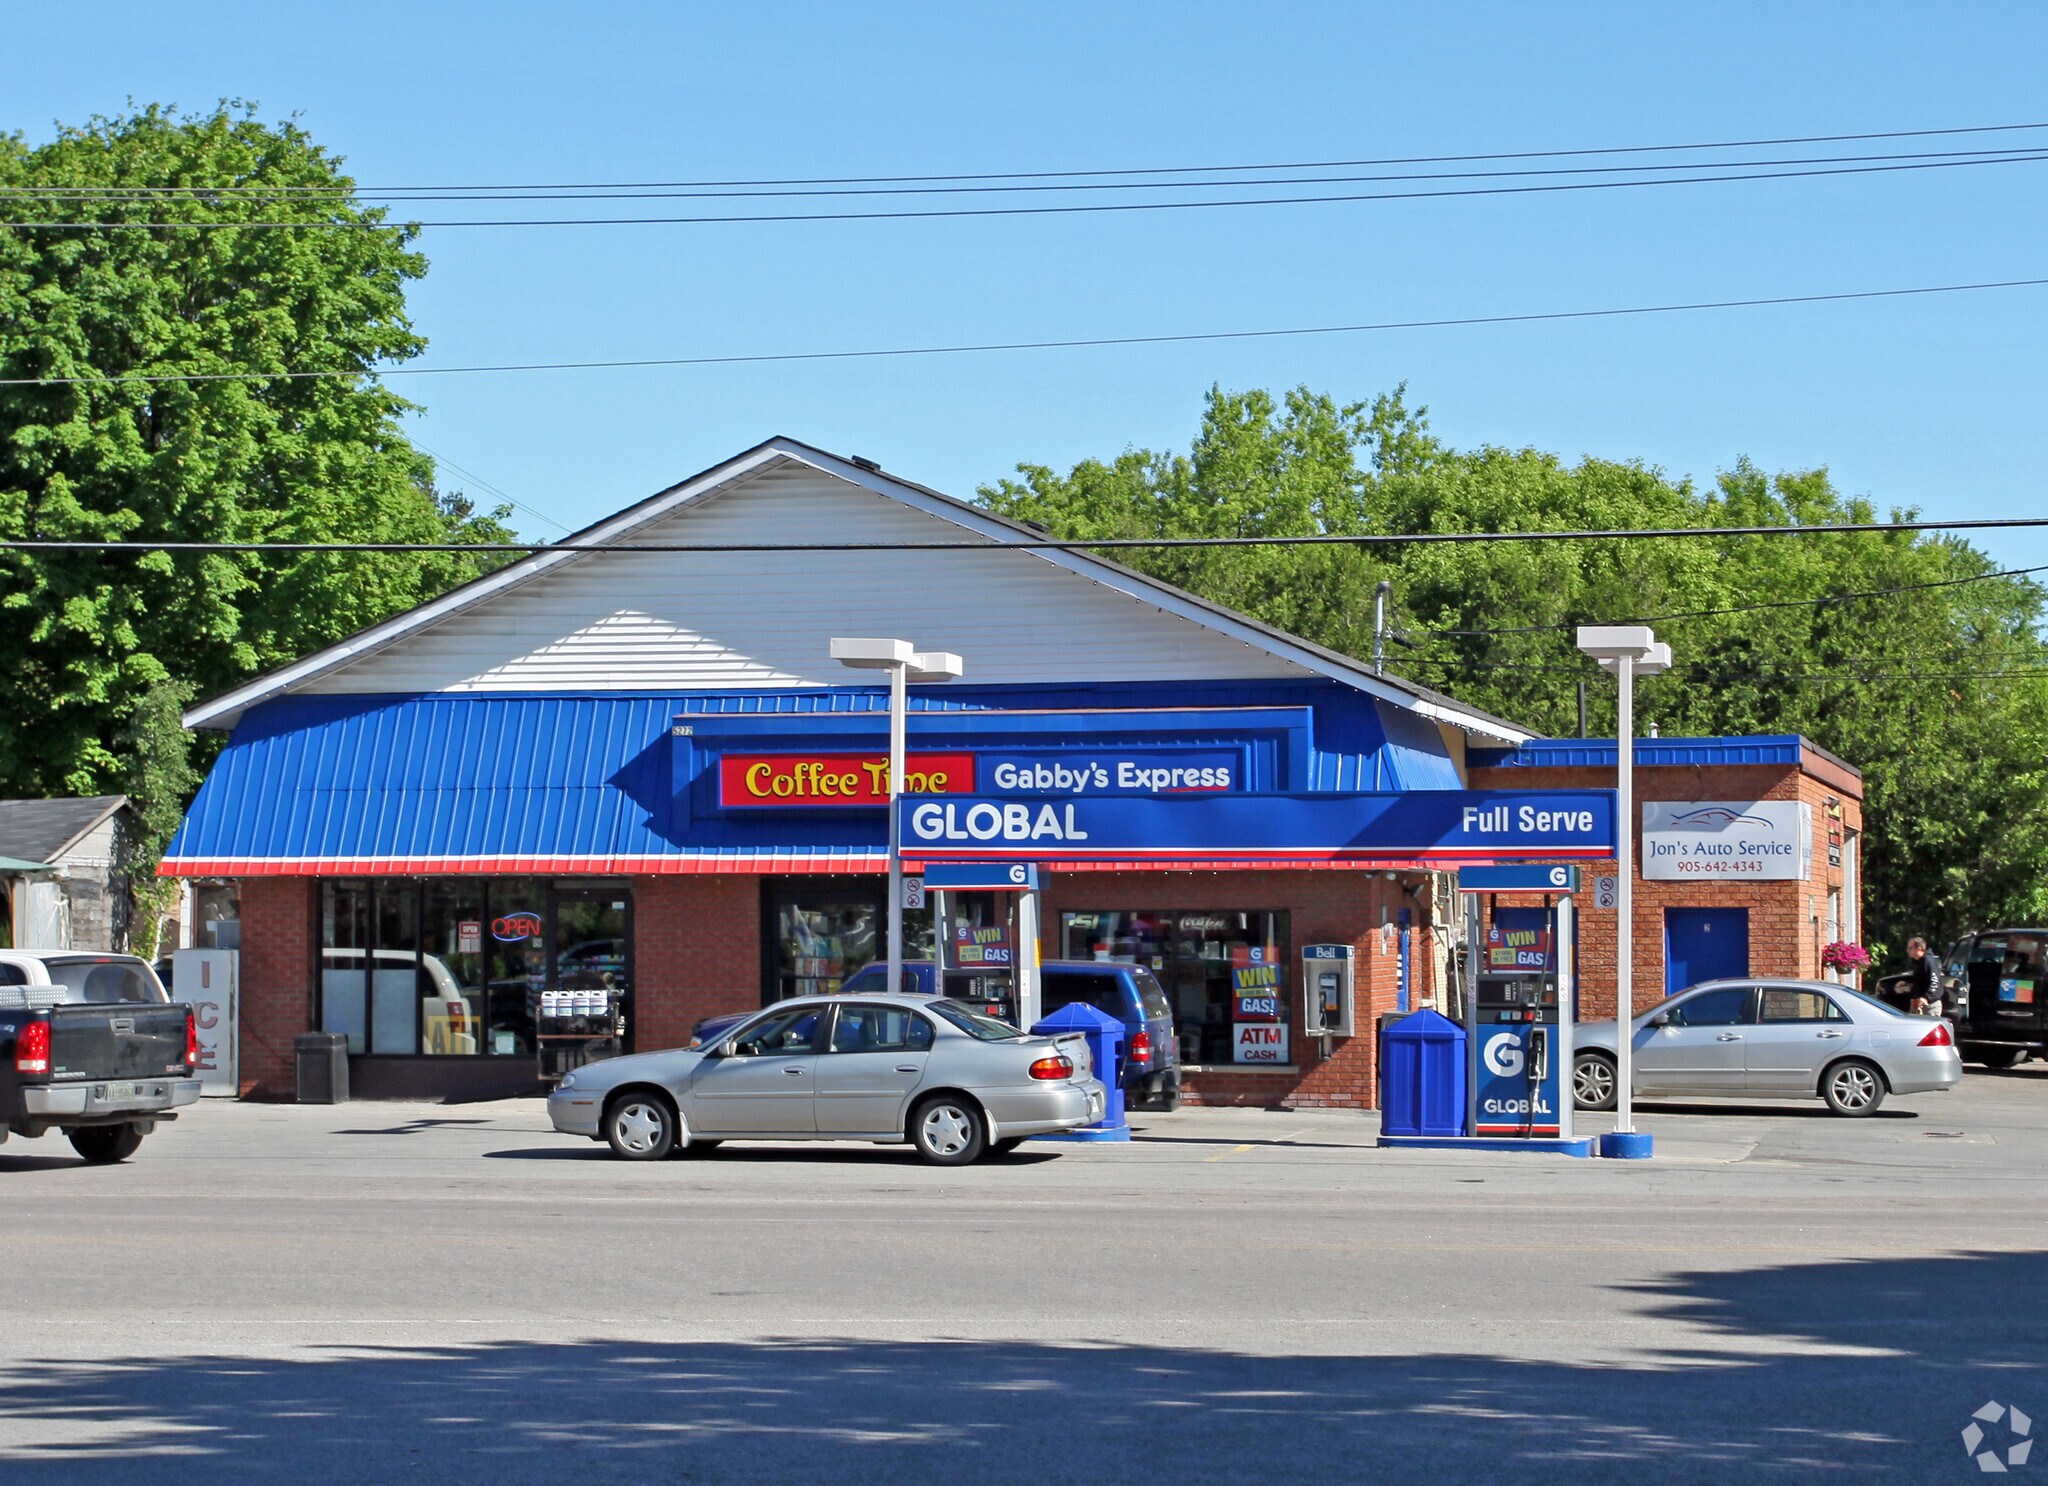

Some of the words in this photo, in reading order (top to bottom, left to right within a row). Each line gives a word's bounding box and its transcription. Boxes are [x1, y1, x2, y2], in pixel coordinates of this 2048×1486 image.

[745, 762, 859, 797] Coffee
[994, 762, 1109, 793] Gabby's
[1117, 763, 1230, 793] Express
[911, 803, 1088, 841] GLOBAL
[1462, 806, 1509, 833] Full
[1518, 805, 1594, 833] Serve
[1650, 840, 1688, 858] Jon's
[1695, 840, 1733, 856] Auto
[1738, 840, 1792, 856] Service
[1009, 864, 1026, 883] G
[1677, 860, 1763, 873] 905-642-4343
[1549, 867, 1567, 886] G
[462, 925, 478, 933] OPEN
[491, 917, 541, 936] OPEN
[973, 928, 1001, 944] WIN
[1506, 930, 1536, 947] WIN
[984, 948, 1009, 961] GAS
[1316, 947, 1335, 958] Bell
[1517, 951, 1544, 965] GAS
[1236, 966, 1276, 988] WIN
[1242, 998, 1275, 1014] GAS!
[1239, 1028, 1282, 1044] ATM
[1244, 1050, 1277, 1060] CASH
[1484, 1098, 1551, 1114] GLOBAL
